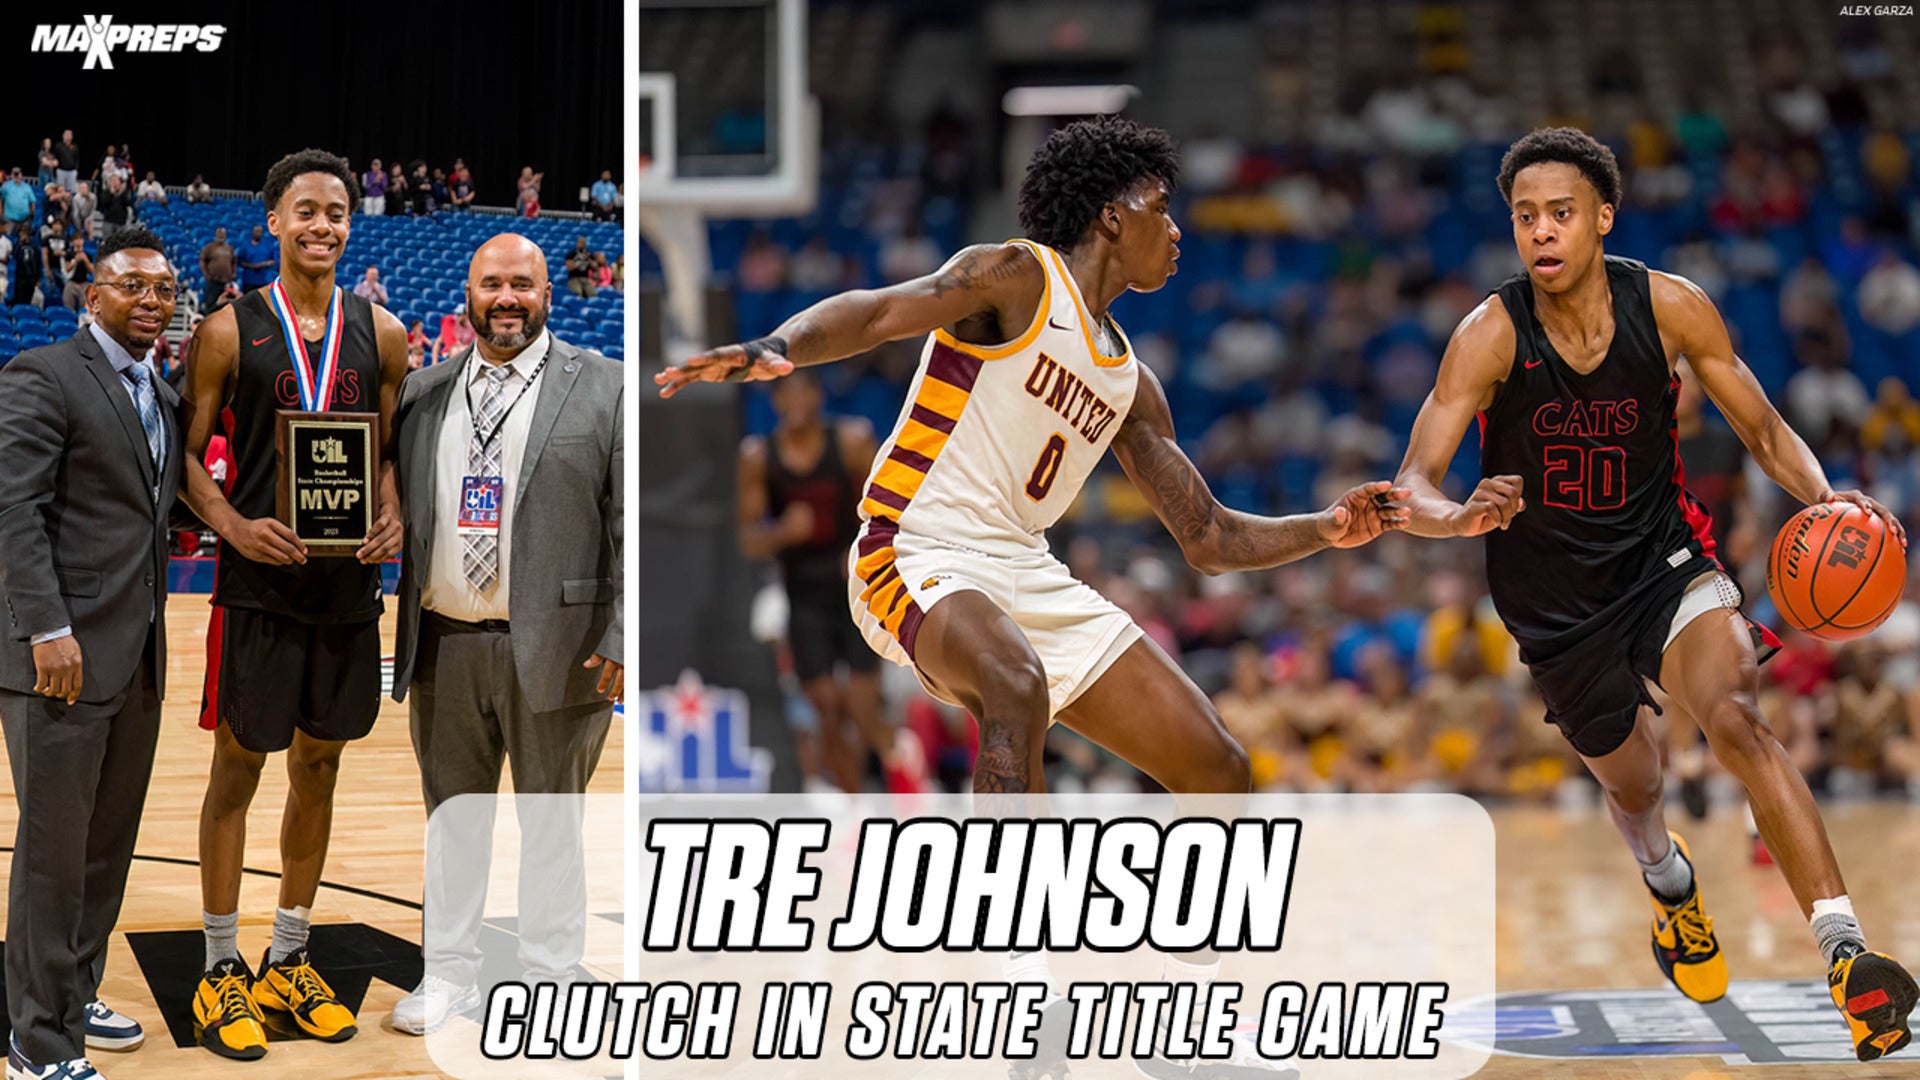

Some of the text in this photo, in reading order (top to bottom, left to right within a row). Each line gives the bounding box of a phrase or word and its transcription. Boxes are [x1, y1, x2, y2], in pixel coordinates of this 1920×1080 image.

[1024, 351, 1118, 446] UNITED
[1532, 398, 1639, 437] CATS
[300, 488, 361, 510] MVP
[1024, 431, 1069, 503] 0
[1543, 444, 1627, 511] 20
